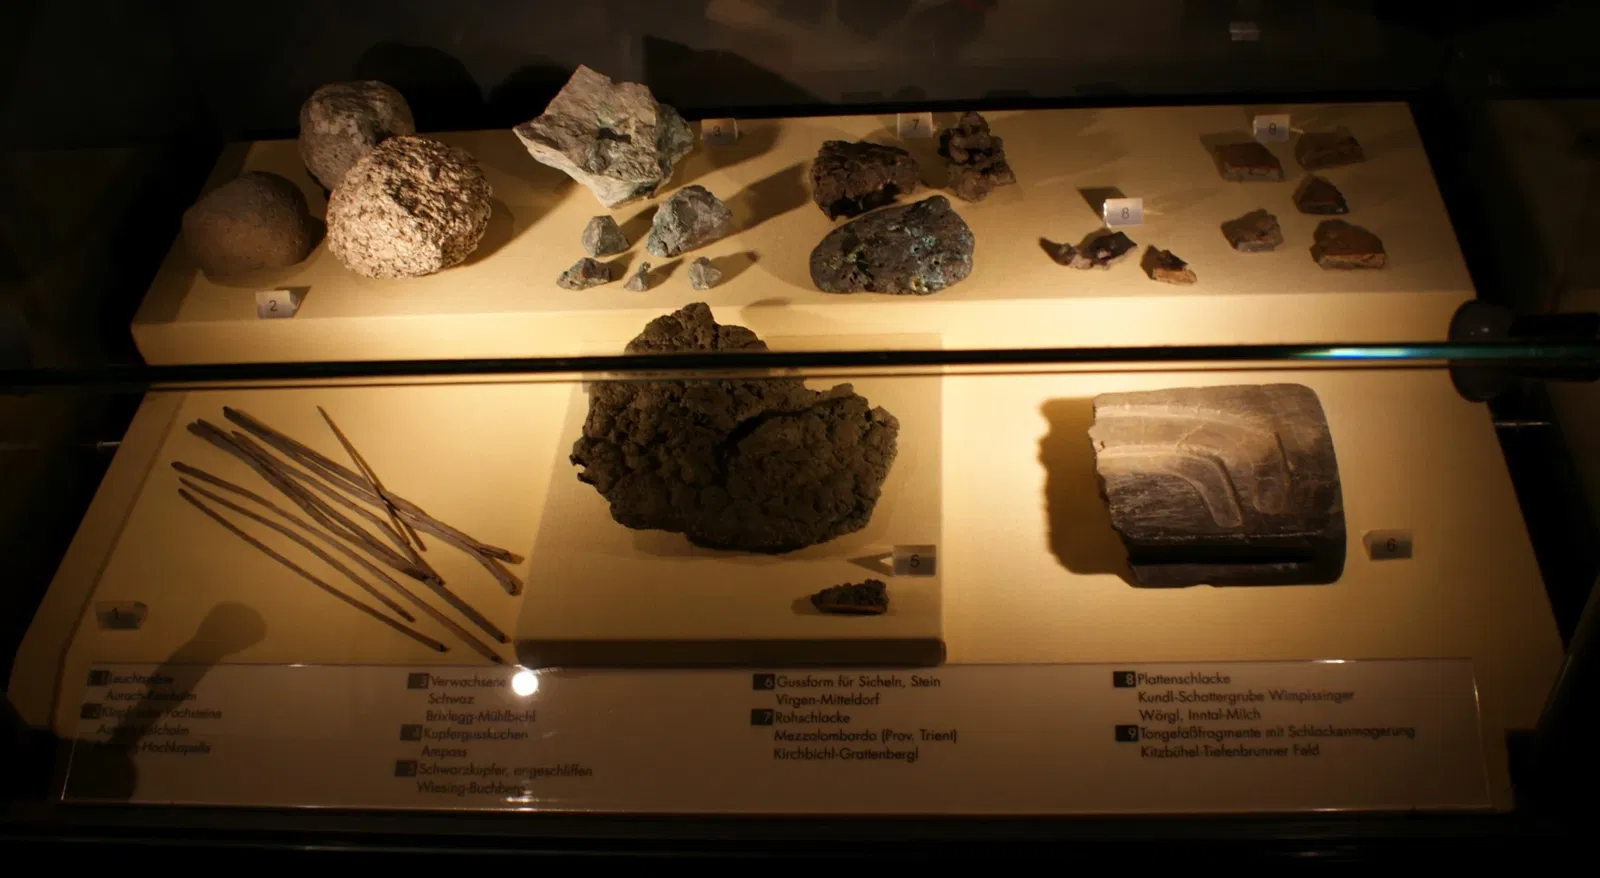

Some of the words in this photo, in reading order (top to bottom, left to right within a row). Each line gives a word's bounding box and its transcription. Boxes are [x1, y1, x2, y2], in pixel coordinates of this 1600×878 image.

[712, 124, 722, 138] 3
[911, 118, 920, 131] 7
[1121, 206, 1131, 220] 8
[268, 298, 278, 312] 2
[1385, 536, 1398, 553] 6
[909, 553, 921, 569] 5
[431, 675, 507, 688] Verwachsene
[776, 675, 834, 689] Gussform
[838, 675, 854, 688] für
[858, 675, 906, 690] Sicheln,
[910, 675, 941, 688] Stein
[1137, 672, 1232, 685] Plattenschlacke
[427, 692, 475, 705] Schwaz
[776, 692, 881, 708] Virgen-Mitteldorf
[1268, 688, 1355, 704] Wimpissinger
[775, 711, 851, 724] Rohschlacke
[1138, 707, 1184, 724] Wörgl,
[1188, 707, 1262, 720] Inntal-Milch
[424, 728, 529, 742] Kupfergusskuchen
[774, 728, 877, 742] Mezzolombardo
[881, 727, 915, 744] (Prov.
[1265, 727, 1285, 738] mit
[421, 745, 468, 760] Ampass
[419, 763, 509, 779] Schwarzkupfer,
